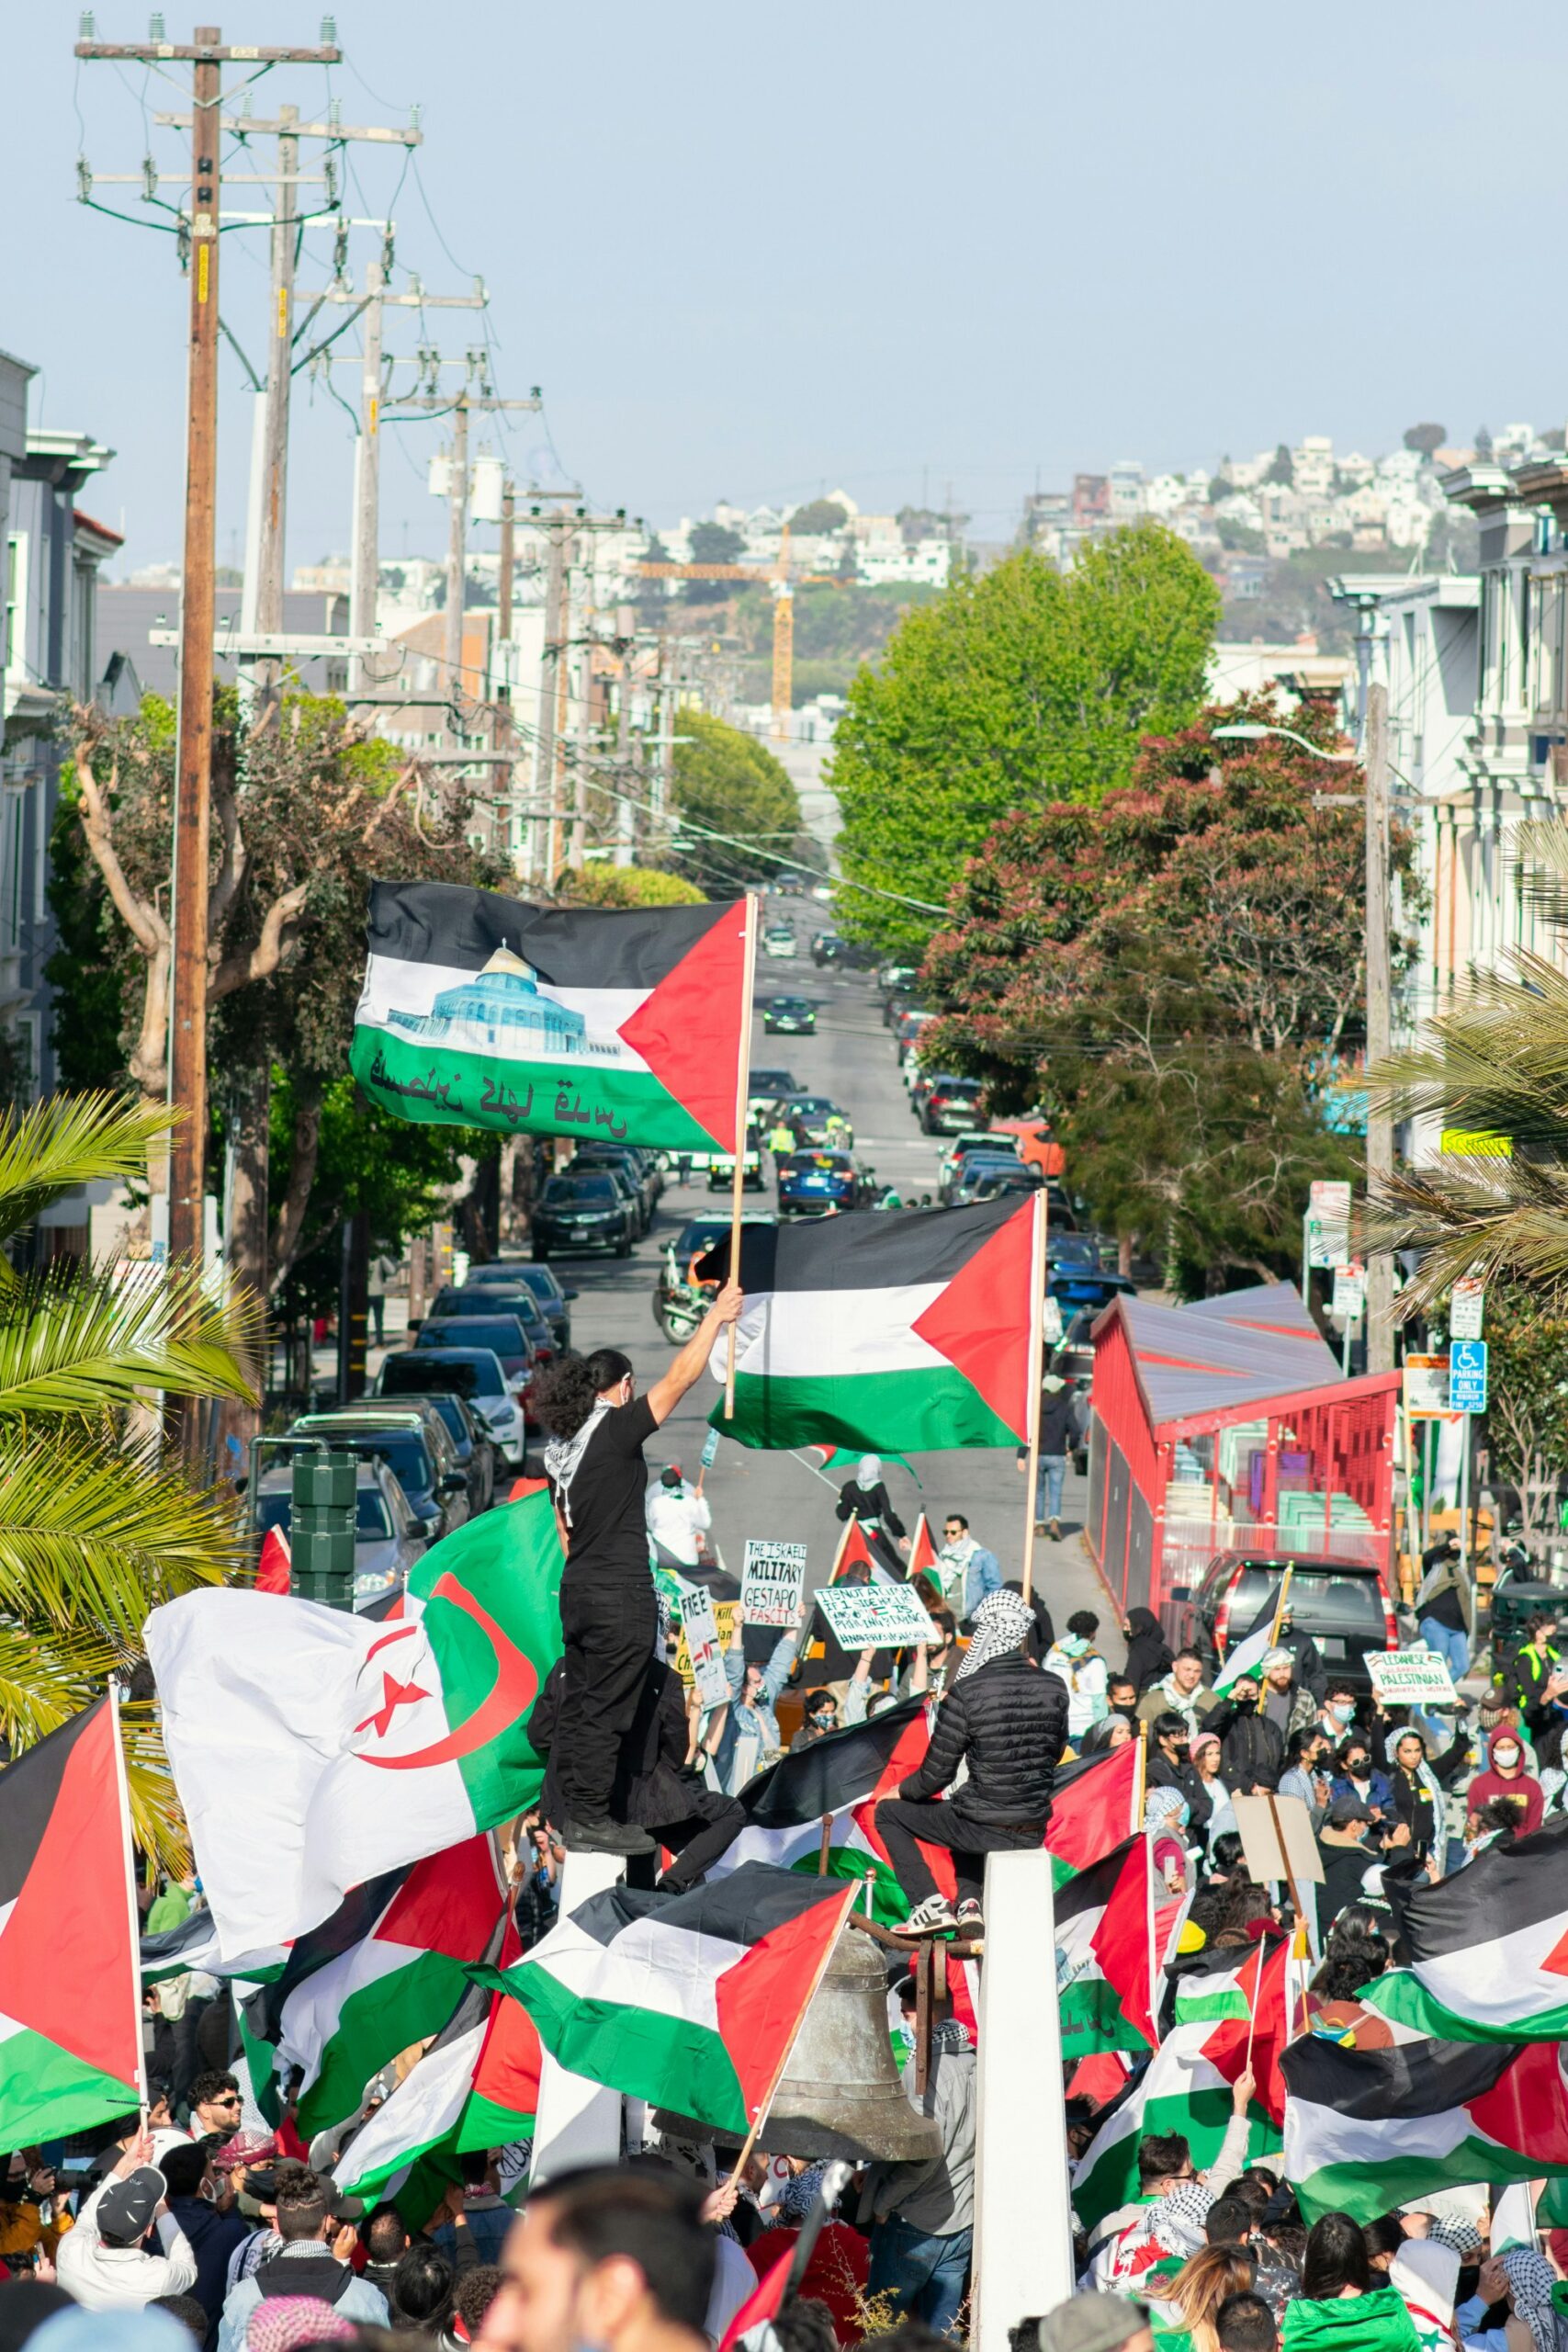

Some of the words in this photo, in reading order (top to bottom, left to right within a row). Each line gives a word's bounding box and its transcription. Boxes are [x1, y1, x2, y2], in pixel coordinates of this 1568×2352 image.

[1452, 1369, 1483, 1380] PARKING
[1458, 1380, 1478, 1391] ONLY
[749, 1543, 764, 1557] THE
[766, 1543, 807, 1560] ISRAELI
[747, 1559, 804, 1585] MILITARY
[867, 1587, 879, 1596] A
[744, 1587, 797, 1611] GESTAPO
[681, 1589, 707, 1623] FREE
[1381, 1654, 1427, 1666] LEBANESE
[1380, 1673, 1444, 1685] PALESTINIAN
